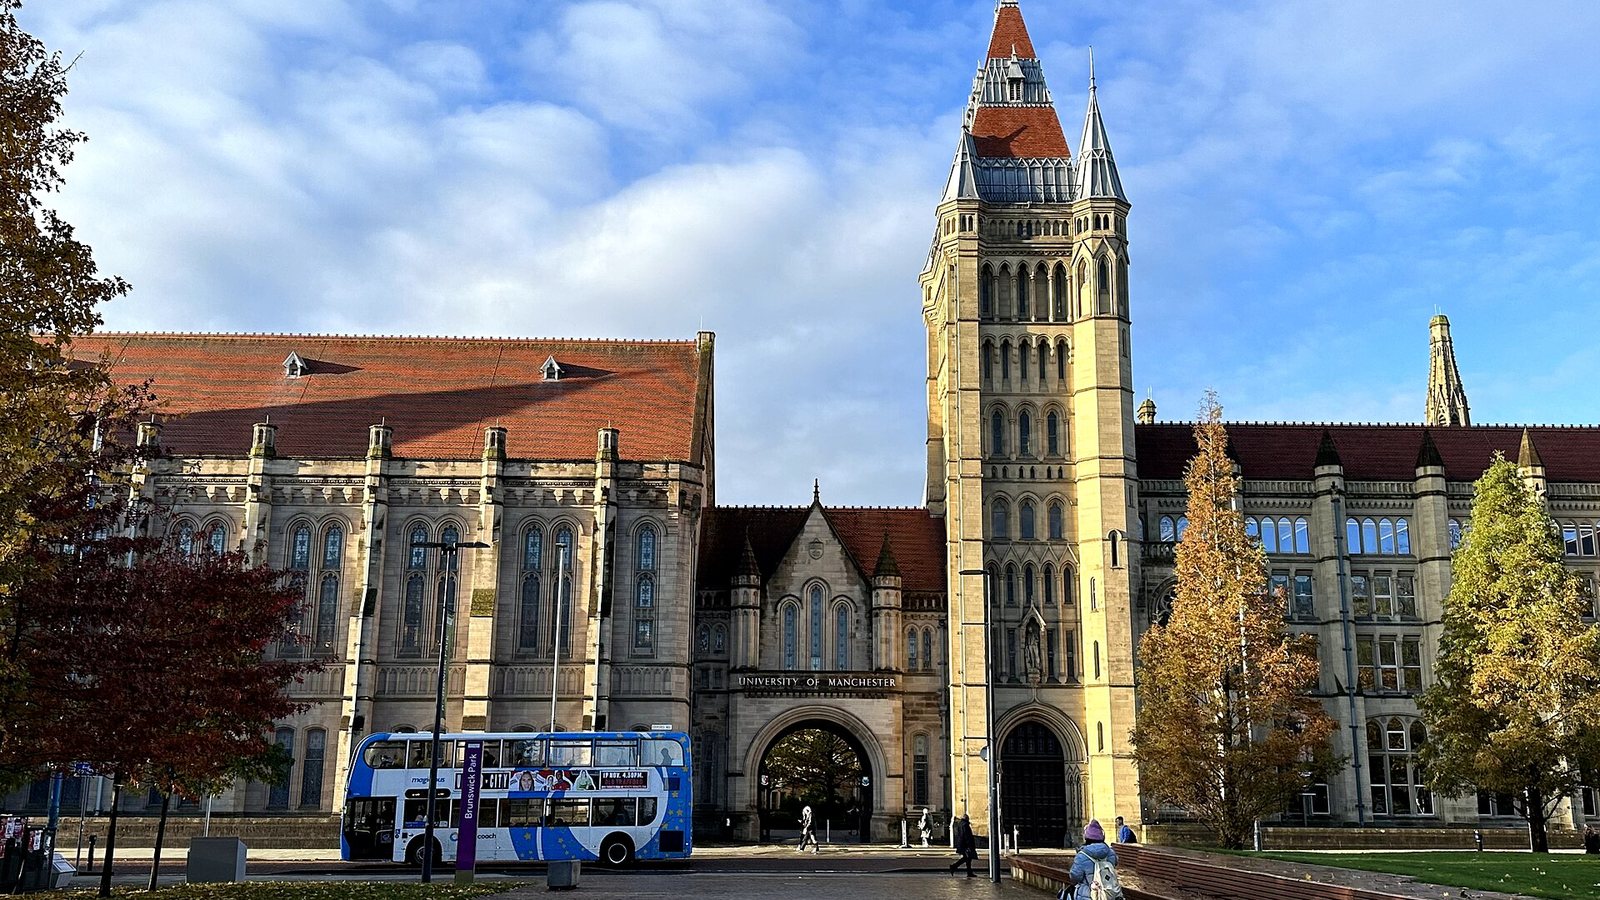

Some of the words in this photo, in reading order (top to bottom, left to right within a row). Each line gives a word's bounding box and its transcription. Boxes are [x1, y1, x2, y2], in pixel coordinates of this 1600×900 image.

[738, 677, 799, 686] UNIVERSITY
[806, 678, 820, 687] OF
[828, 678, 896, 687] MANCHESTER
[467, 753, 477, 773] Park
[489, 773, 508, 789] CITY
[464, 774, 476, 819] Brunswick
